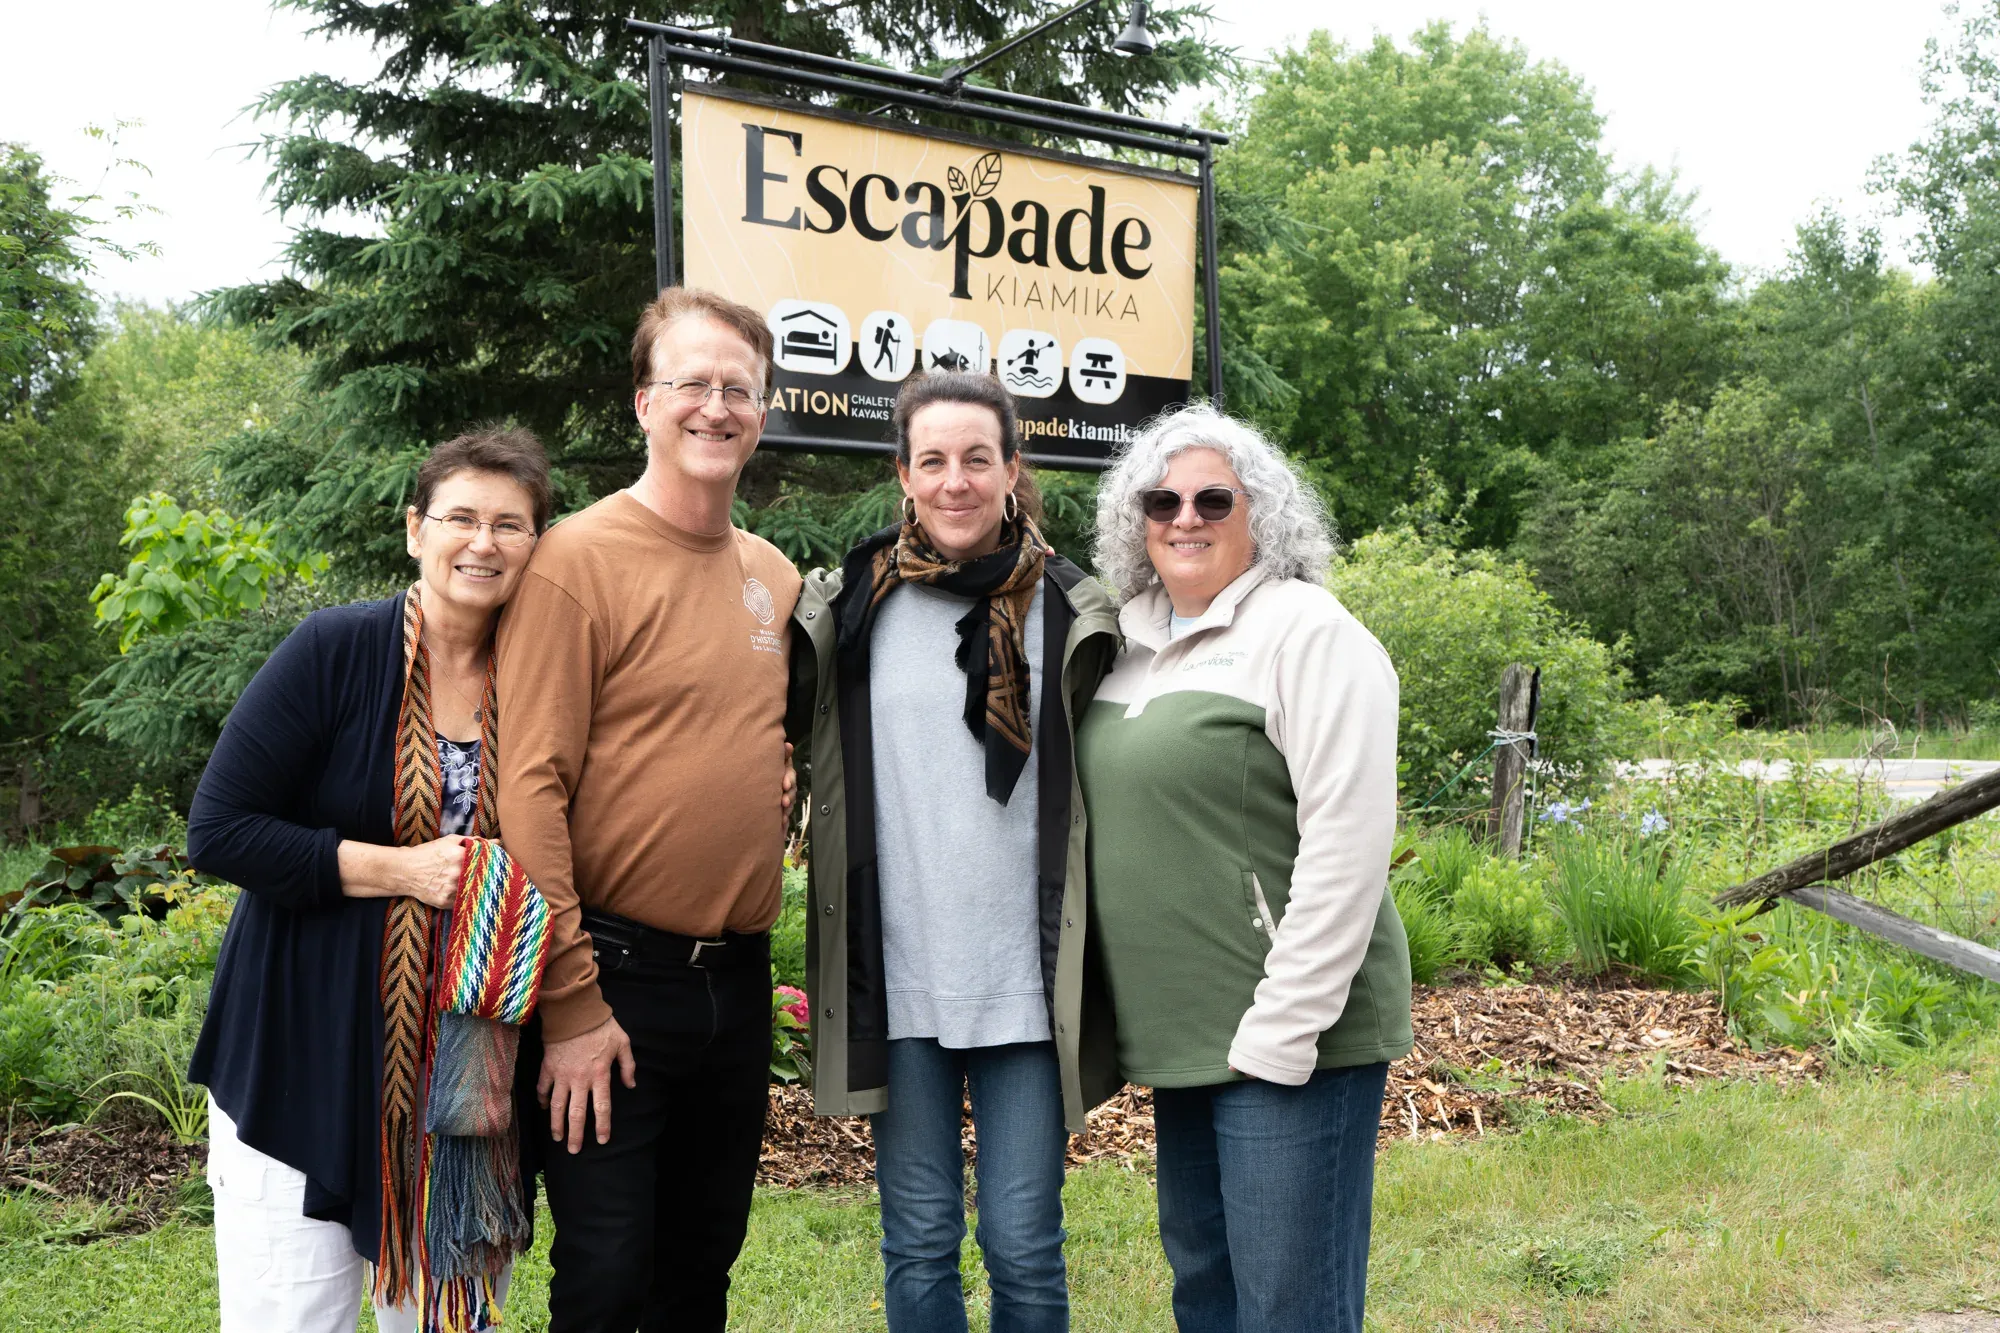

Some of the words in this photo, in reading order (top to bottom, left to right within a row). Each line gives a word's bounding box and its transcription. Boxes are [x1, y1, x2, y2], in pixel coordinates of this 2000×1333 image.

[741, 123, 1153, 300] Escapade
[987, 272, 1140, 322] KIAMIKA
[850, 394, 896, 409] CHALETS
[850, 407, 890, 421] KAYAKS
